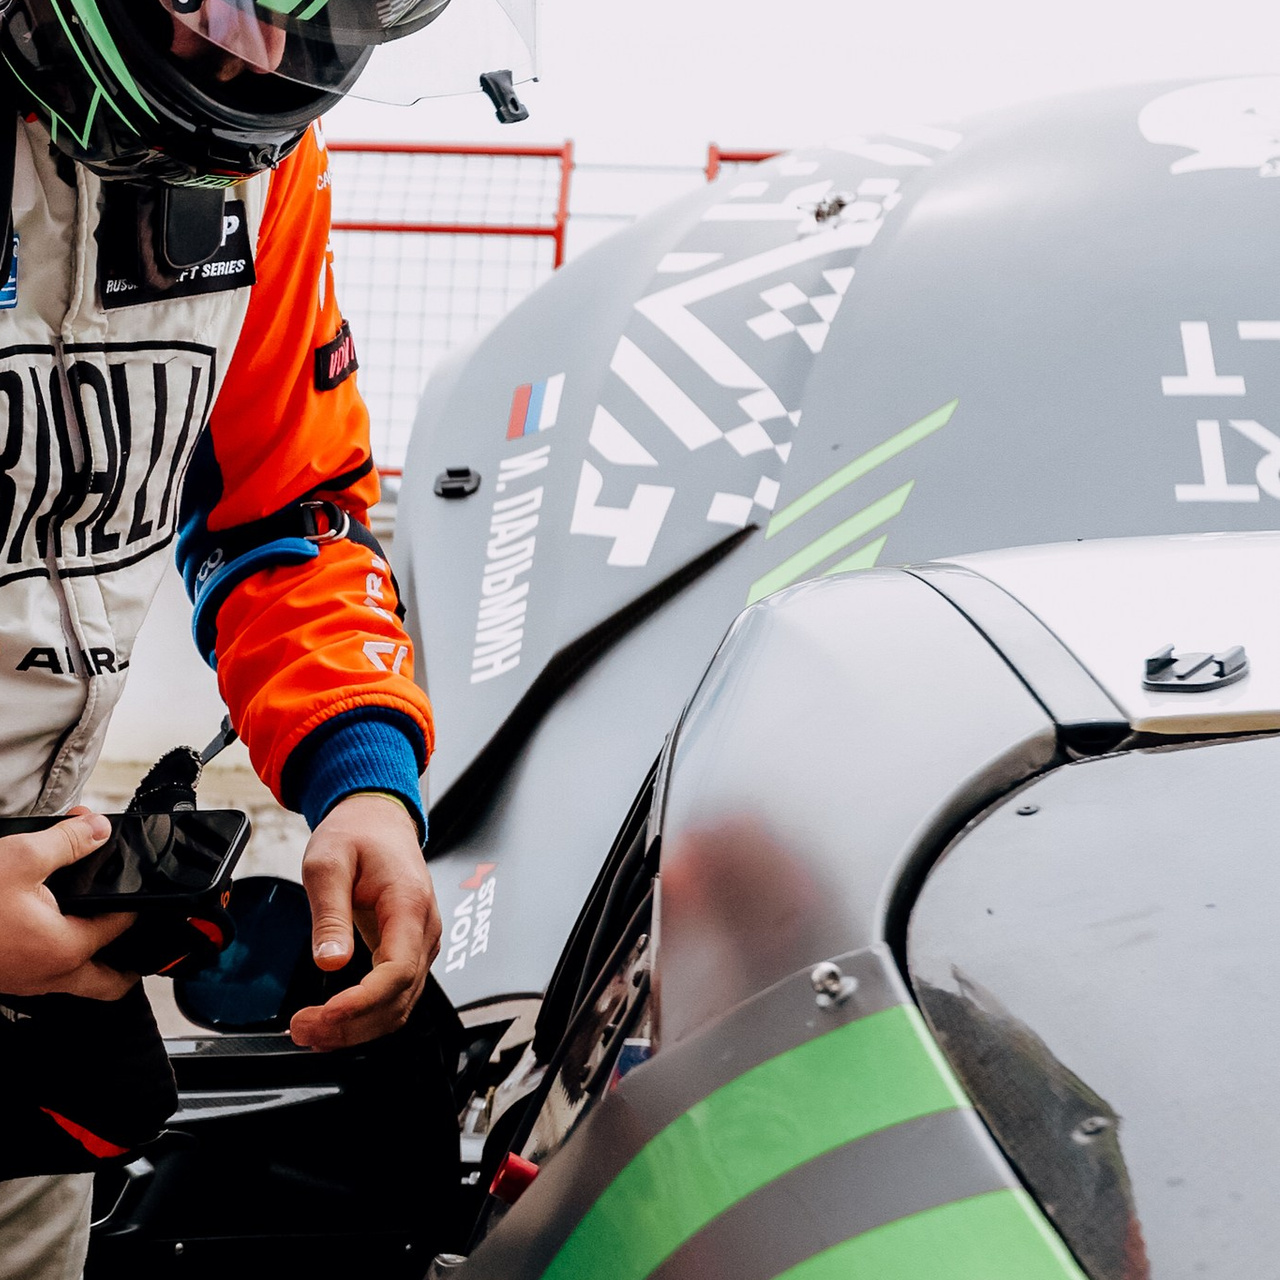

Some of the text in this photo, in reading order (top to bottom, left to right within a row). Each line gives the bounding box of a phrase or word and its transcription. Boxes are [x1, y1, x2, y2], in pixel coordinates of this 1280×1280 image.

[201, 259, 246, 277] SERIES
[470, 486, 544, 685] ПАЛЬМИН
[445, 891, 475, 974] VOLT
[470, 876, 496, 958] START
